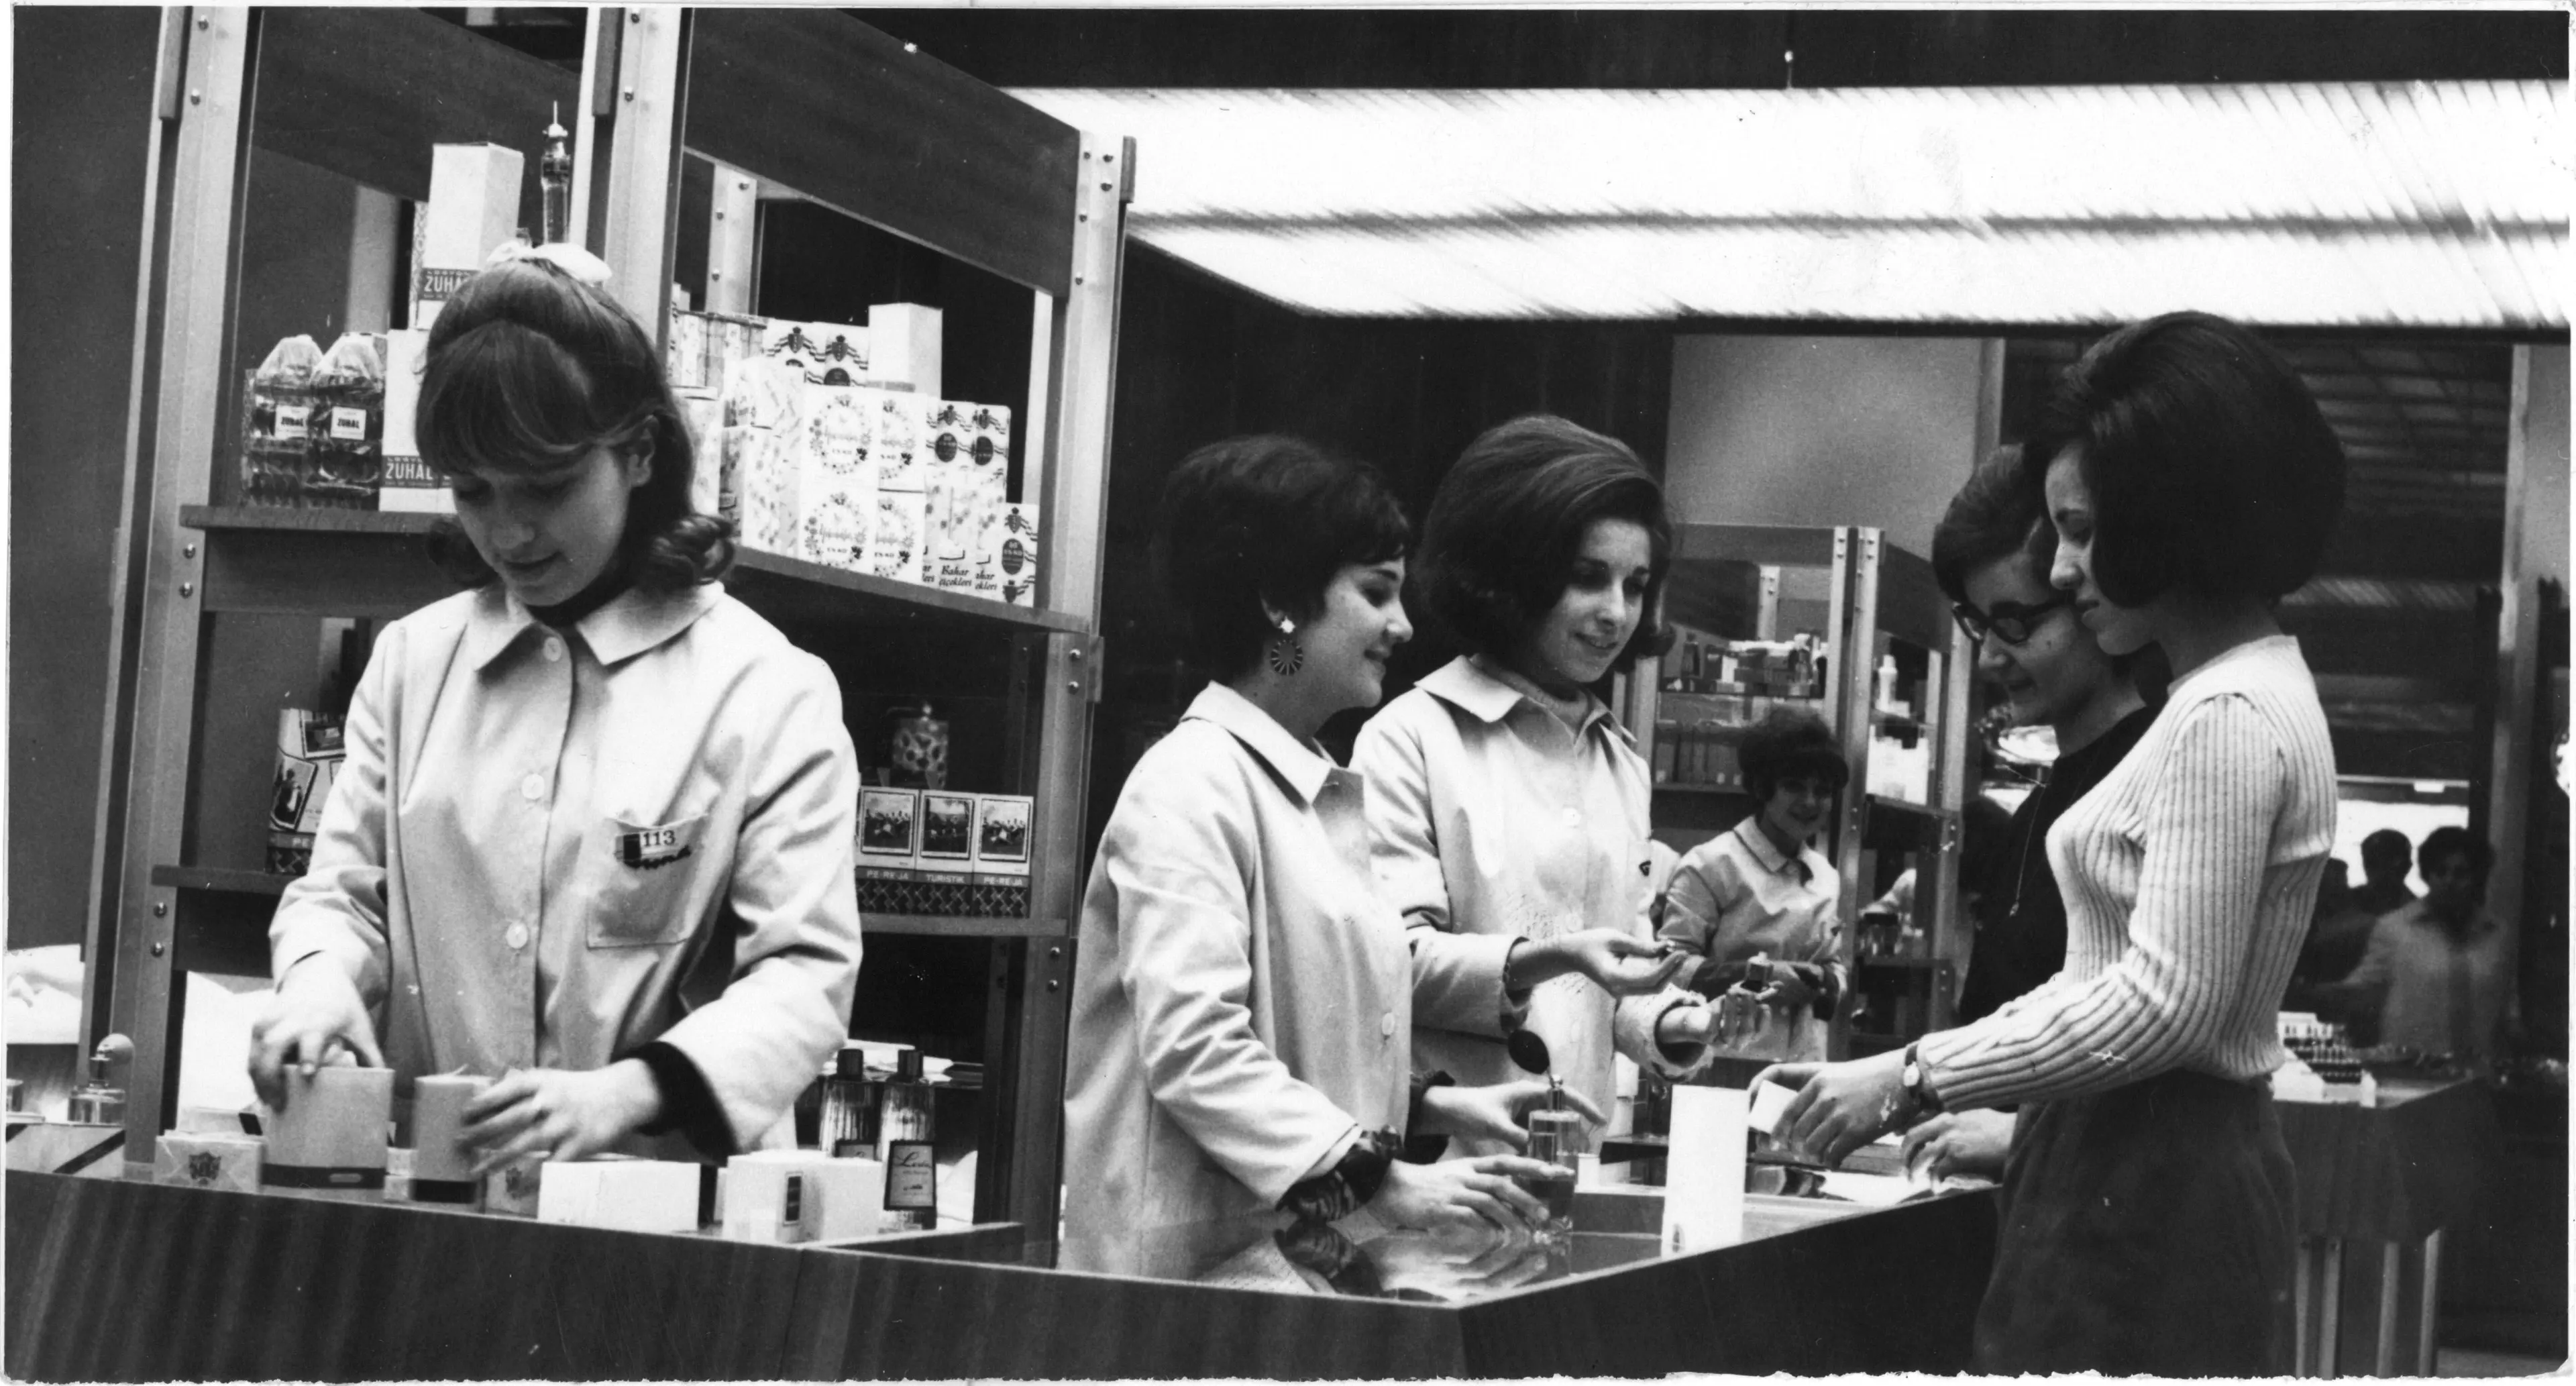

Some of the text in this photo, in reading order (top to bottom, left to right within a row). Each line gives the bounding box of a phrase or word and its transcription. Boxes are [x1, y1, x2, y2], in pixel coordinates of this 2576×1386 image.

[424, 275, 463, 292] ZUHA
[337, 418, 360, 429] ZUHAL
[386, 462, 433, 480] ZUHAL
[941, 564, 969, 576] Bahar
[643, 829, 676, 847] 113
